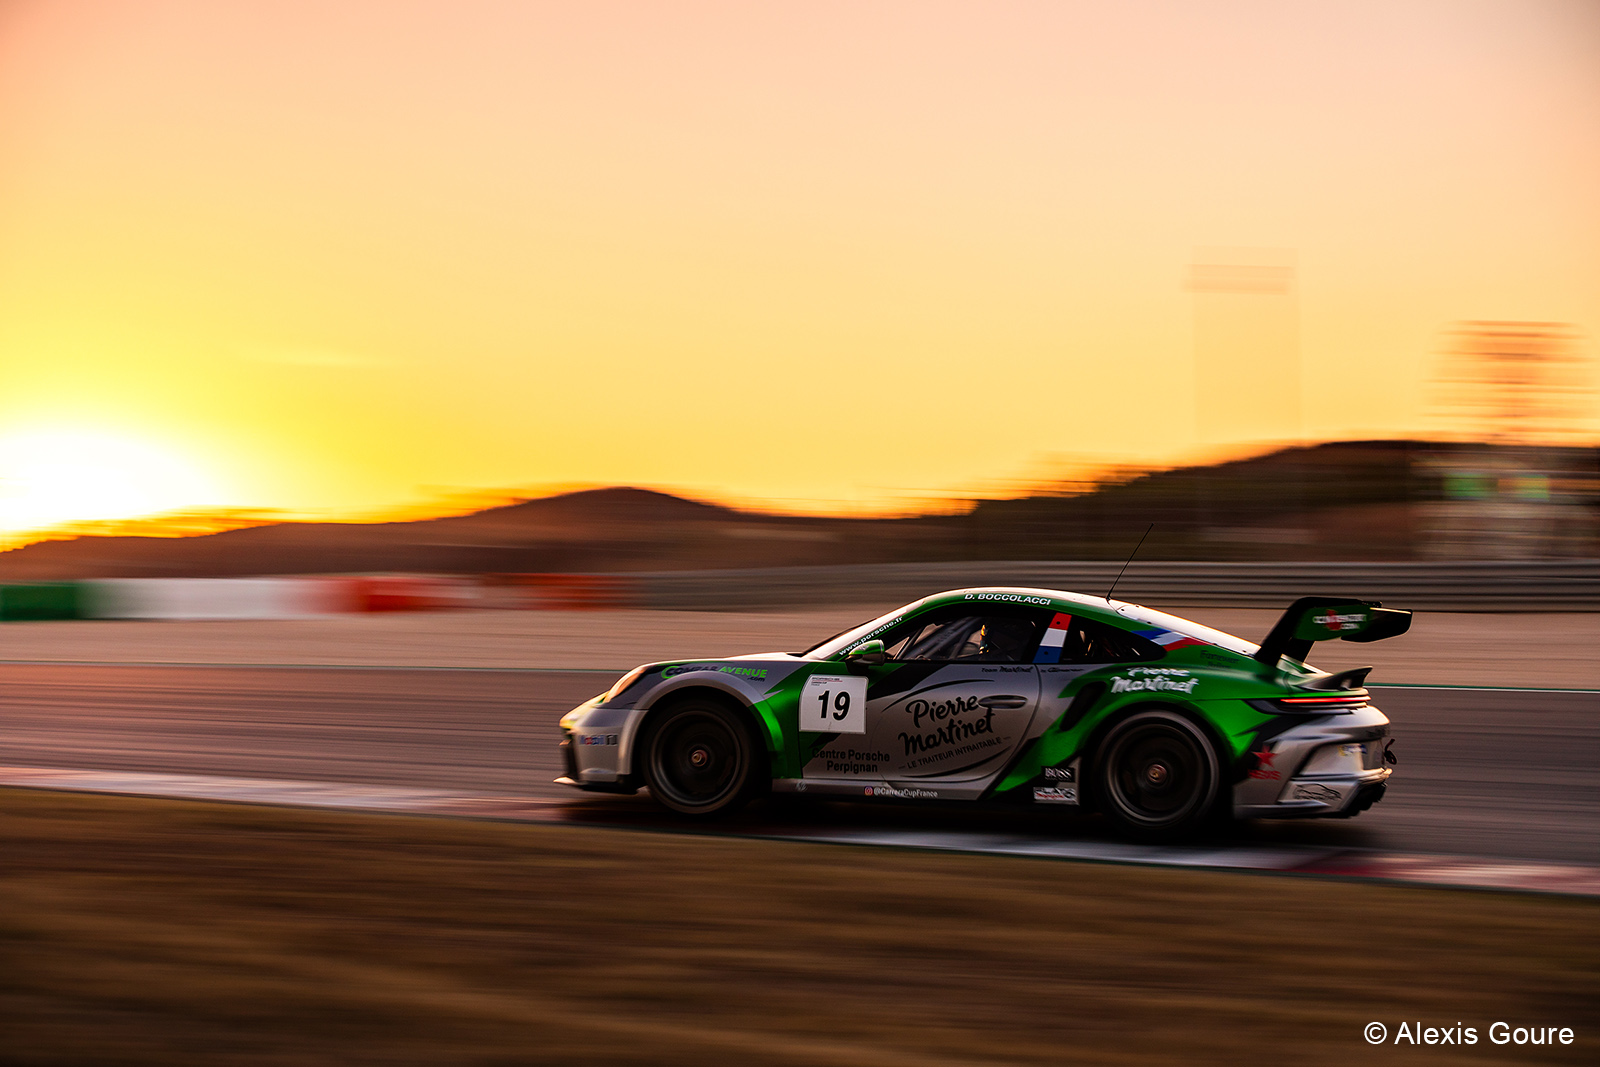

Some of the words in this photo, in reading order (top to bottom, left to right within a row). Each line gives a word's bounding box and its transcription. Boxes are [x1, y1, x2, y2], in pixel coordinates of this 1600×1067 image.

[965, 593, 976, 601] D.
[977, 593, 1052, 606] BOCCOLACCI
[839, 616, 903, 656] www.porsche.fr
[818, 690, 851, 721] 19
[905, 695, 979, 728] Pierre
[898, 706, 996, 756] Martinet
[811, 747, 846, 759] Centre
[848, 749, 890, 762] Porsche
[826, 761, 878, 775] Perpignan
[907, 761, 917, 769] LE
[919, 751, 954, 767] TRAITEUR
[955, 736, 1003, 756] INTRAITABLE
[873, 787, 938, 798] @CarreraCupFrance
